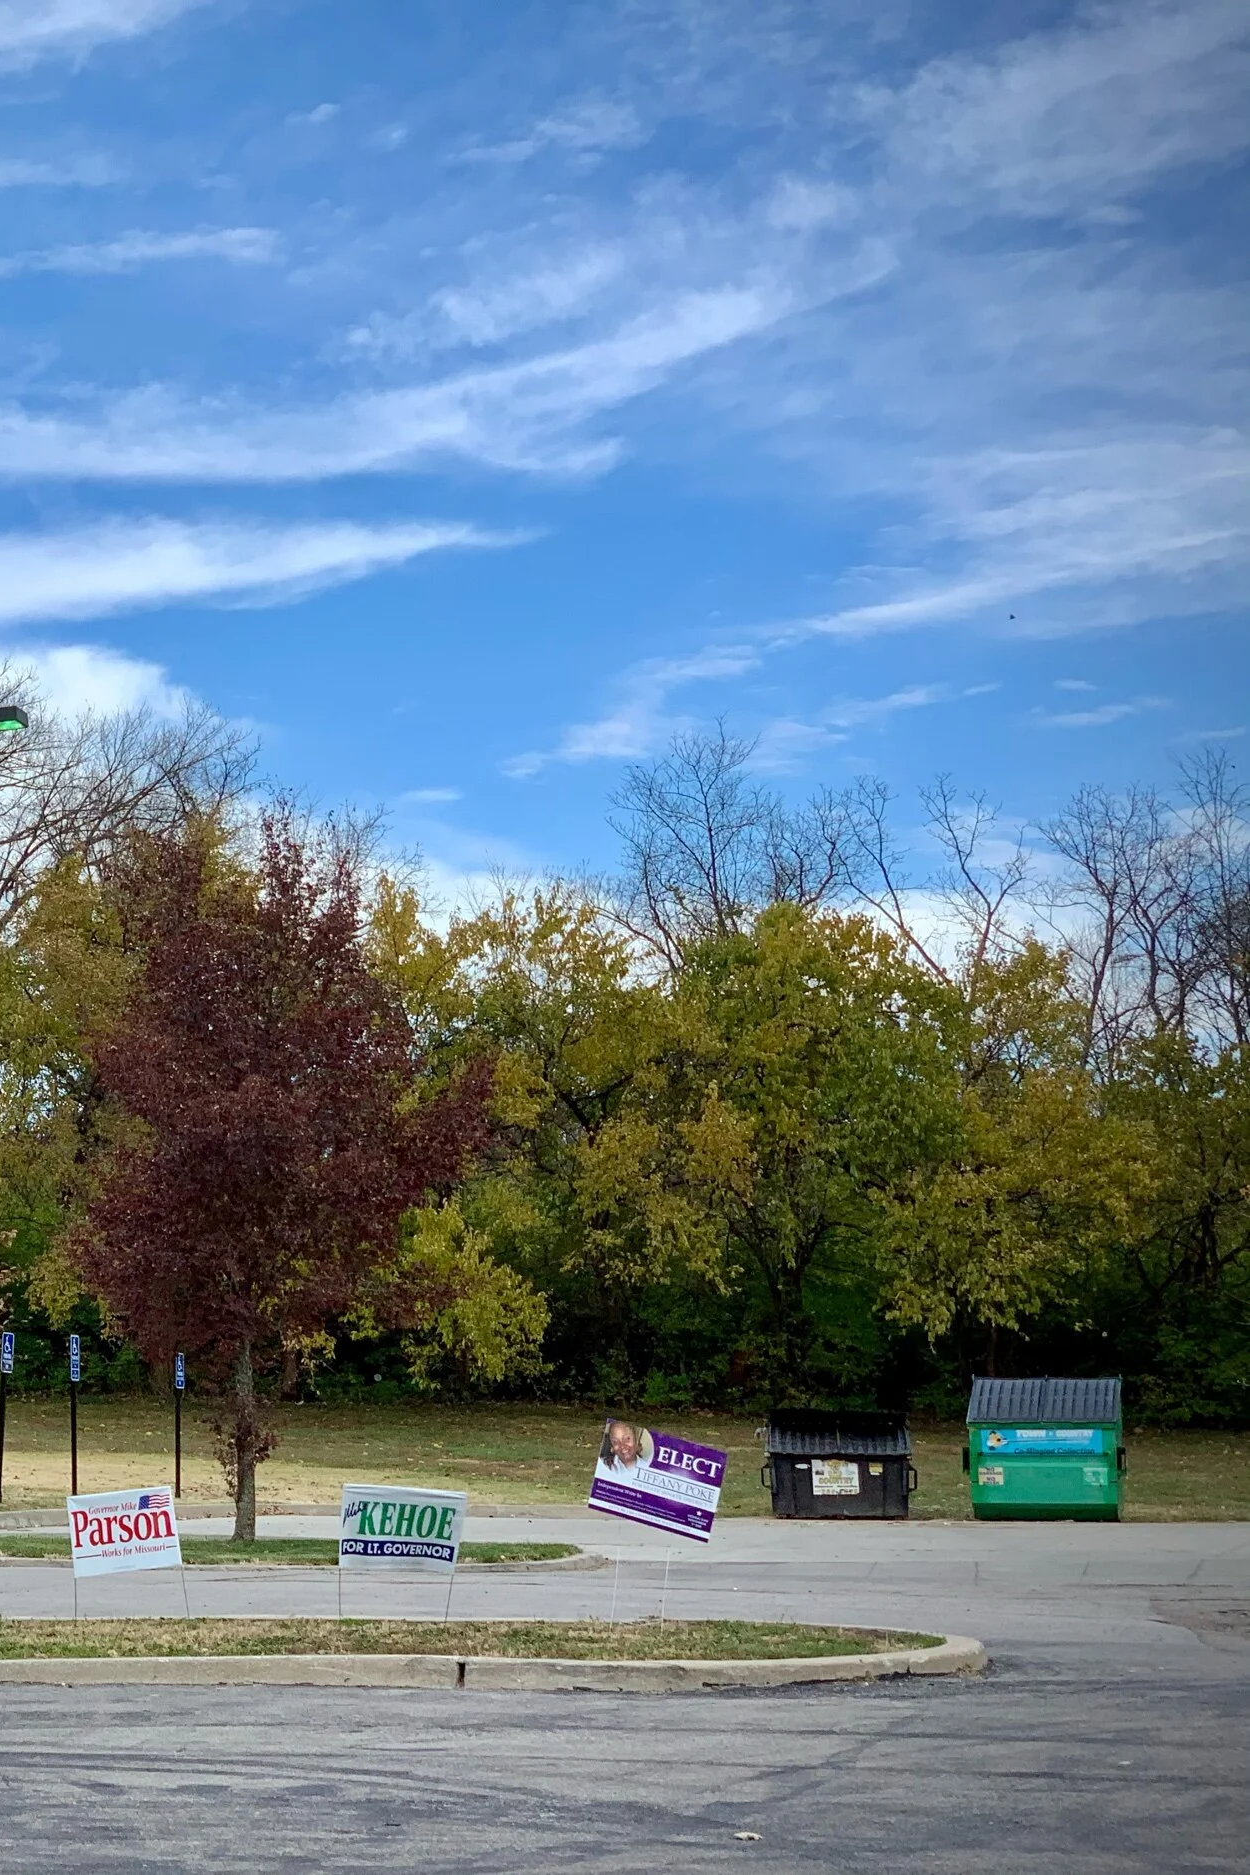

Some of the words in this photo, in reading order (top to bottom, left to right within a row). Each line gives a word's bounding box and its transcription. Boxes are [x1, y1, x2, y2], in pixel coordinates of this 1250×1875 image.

[657, 1446, 722, 1478] ELECT
[636, 1467, 683, 1491] TIFFANY
[684, 1484, 715, 1500] POKE
[89, 1505, 119, 1515] Governor
[121, 1502, 137, 1511] Mike
[357, 1501, 456, 1540] KEHOE
[71, 1510, 175, 1548] Parson
[101, 1549, 121, 1558] Works
[123, 1547, 132, 1557] for
[134, 1543, 166, 1554] Missouri
[342, 1541, 365, 1553] FOR
[367, 1543, 381, 1554] LT.
[384, 1543, 451, 1559] GOVERNOR
